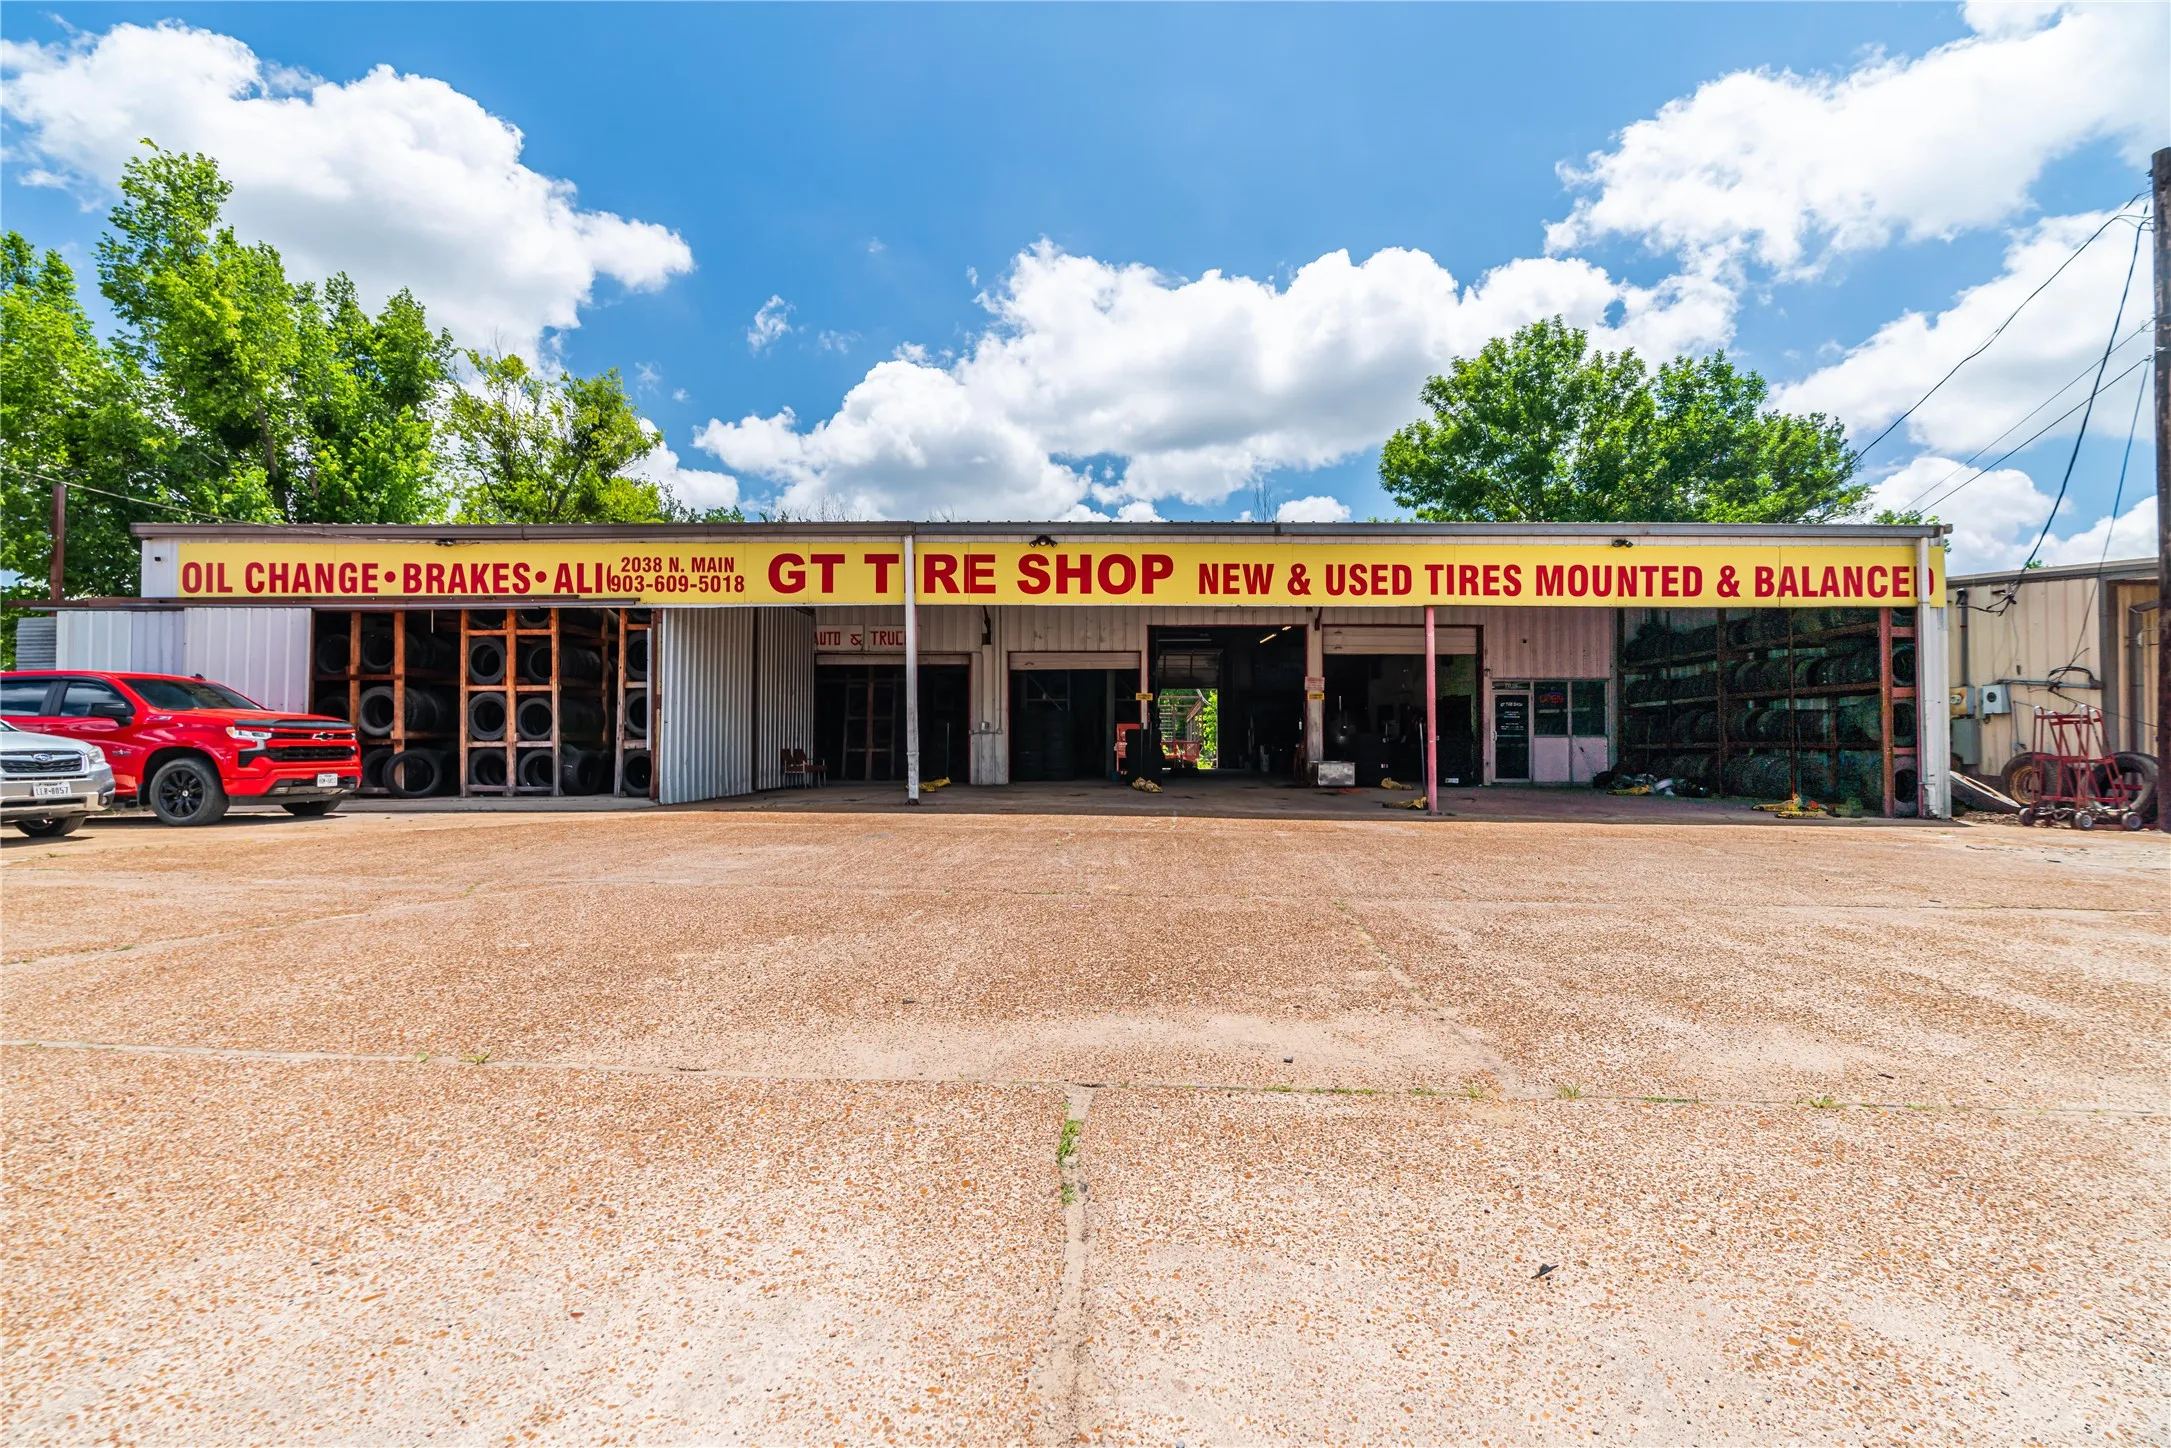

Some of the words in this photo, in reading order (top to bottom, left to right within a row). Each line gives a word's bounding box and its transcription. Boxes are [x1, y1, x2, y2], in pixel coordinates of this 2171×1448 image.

[620, 557, 662, 573] 2038
[668, 557, 685, 573] N.
[691, 557, 735, 573] MAIN
[768, 553, 845, 594] GT
[863, 553, 997, 594] TRE
[1017, 553, 1174, 595] SHOP
[183, 562, 233, 593] OIL
[245, 562, 379, 594] CHANGE
[403, 563, 531, 594] BRAKES
[553, 563, 612, 593] ALI
[611, 575, 745, 593] 903-609-5018
[1199, 563, 1274, 595] NEW
[1287, 563, 1311, 596] &
[1325, 564, 1412, 596] USED
[1424, 564, 1522, 597] TIRES
[1535, 565, 1703, 598] MOUNTED
[1716, 566, 1740, 598] &
[850, 633, 863, 646] &
[870, 630, 907, 646] TRUC
